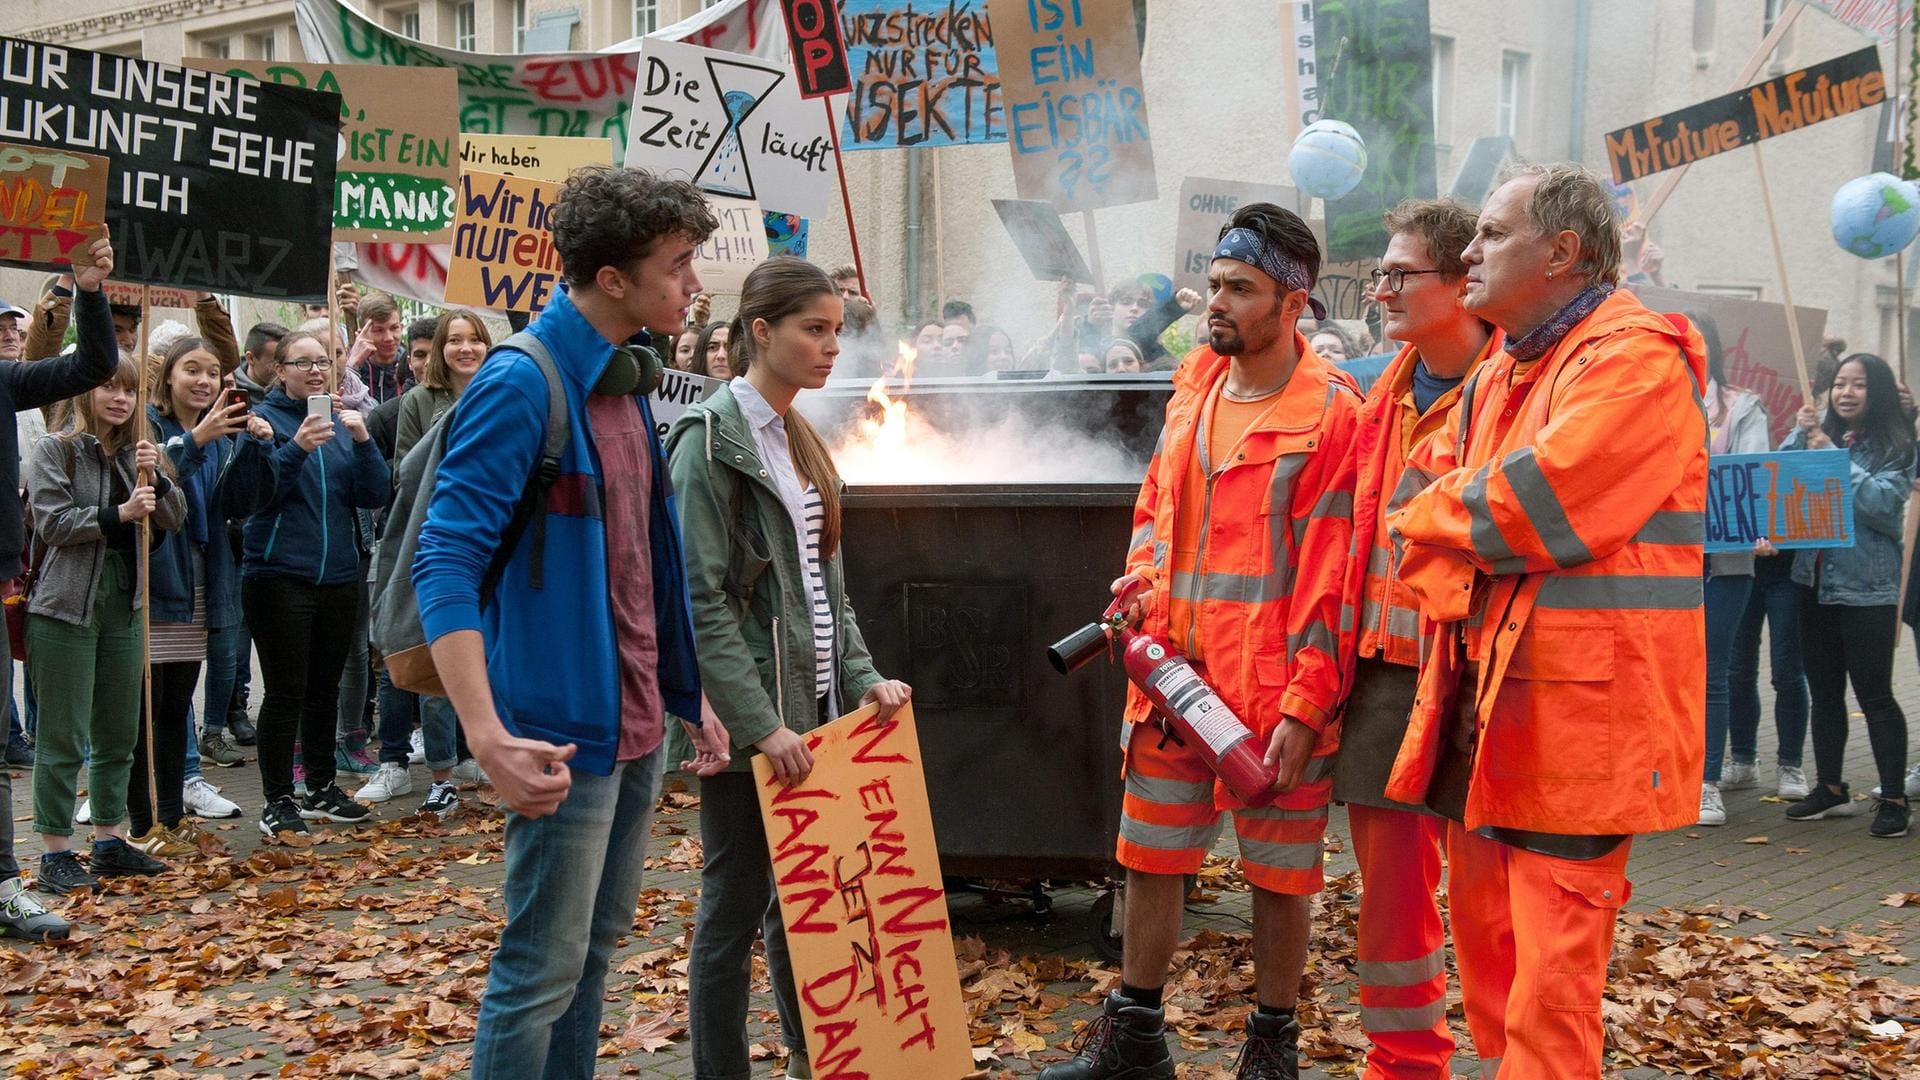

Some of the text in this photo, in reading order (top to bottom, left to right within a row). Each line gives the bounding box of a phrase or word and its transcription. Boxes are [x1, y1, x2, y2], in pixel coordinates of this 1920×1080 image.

[91, 53, 260, 121] UNSERE
[643, 56, 700, 102] Die
[210, 126, 315, 184] SEHE
[351, 128, 449, 168] IST EIN
[492, 147, 540, 168] haben
[639, 106, 710, 149] Zeit
[761, 122, 833, 171] läuft
[122, 171, 189, 215] ICH
[463, 174, 524, 224] Wir
[455, 222, 518, 265] nur
[657, 373, 703, 405] Wir
